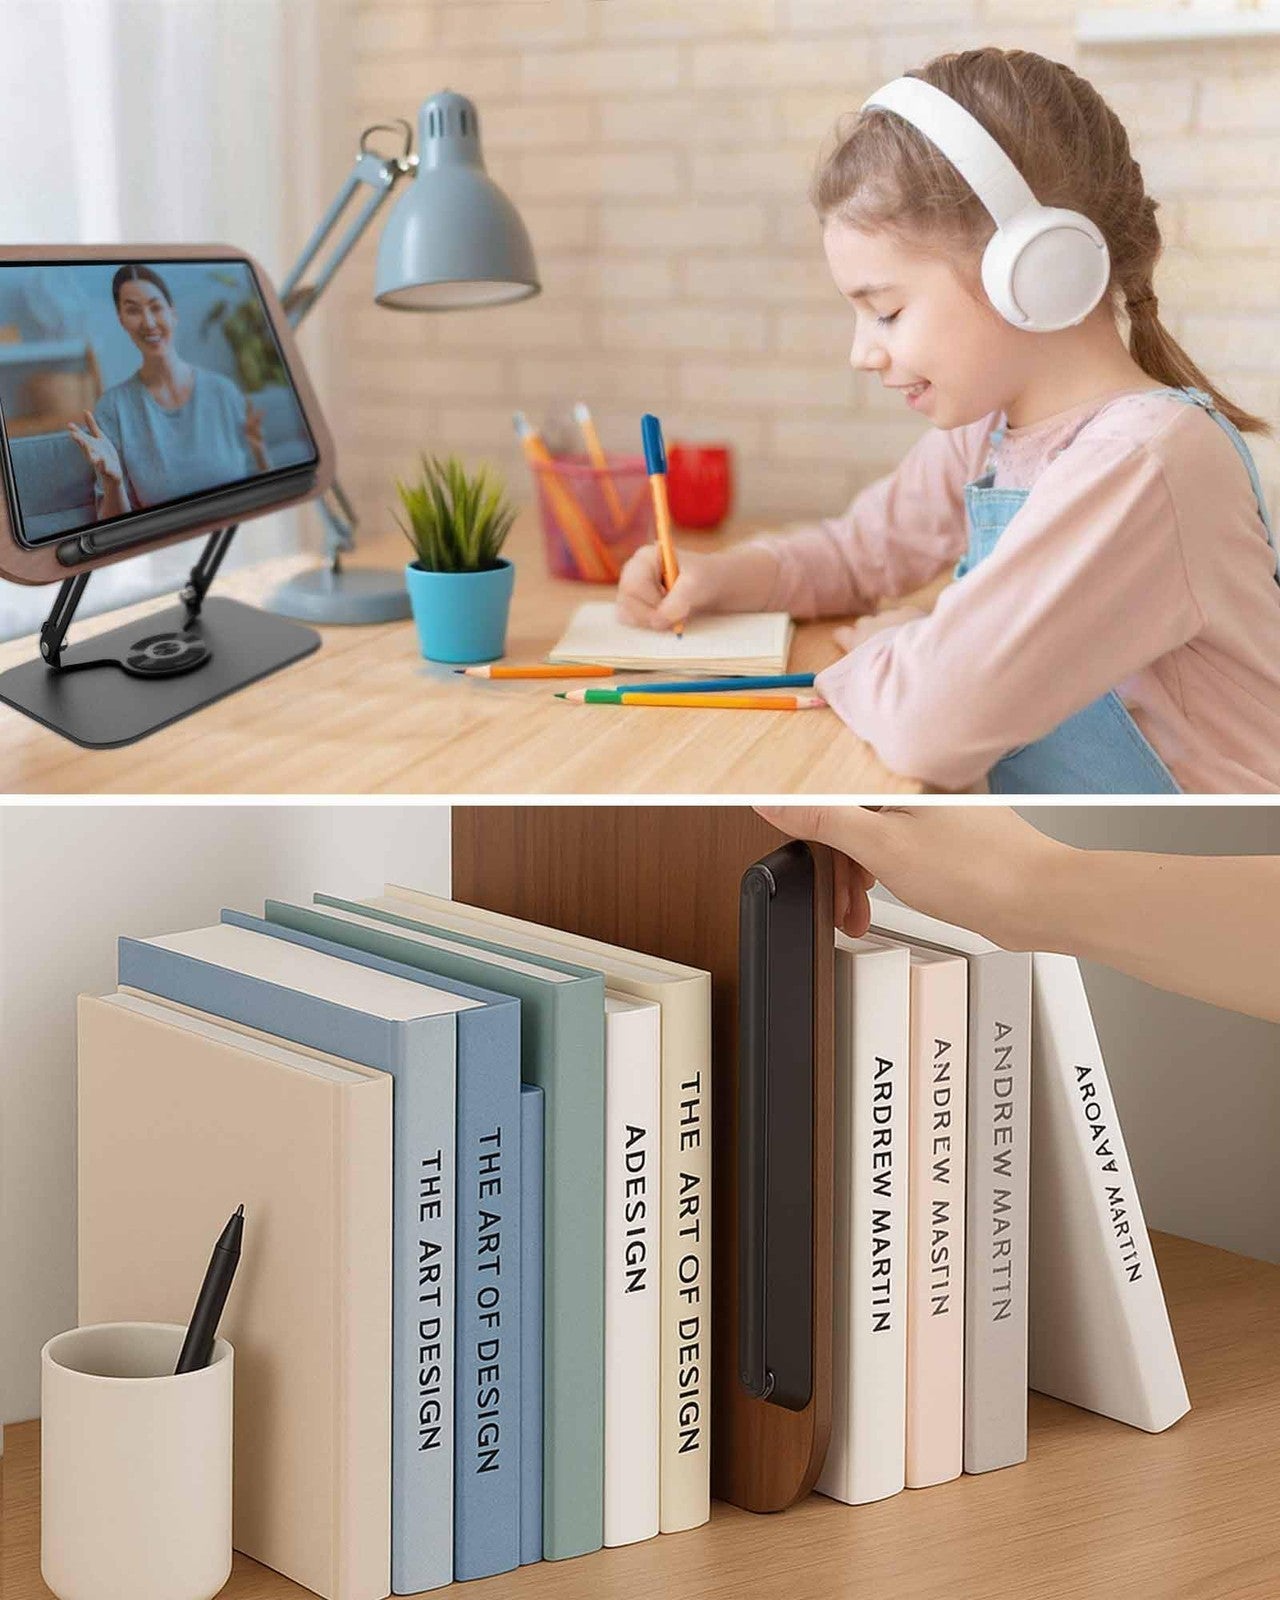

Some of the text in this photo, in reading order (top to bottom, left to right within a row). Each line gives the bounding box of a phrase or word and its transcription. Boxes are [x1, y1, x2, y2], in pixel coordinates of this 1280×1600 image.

[625, 1125, 647, 1293] ADESIGN
[871, 1056, 894, 1333] ARDREW MARTIN
[932, 1038, 952, 1184] ANDREW
[992, 1021, 1013, 1177] ANDREW
[418, 1149, 442, 1452] THE ART DESIGN
[476, 1126, 502, 1474] THE ART OF DESIGN
[678, 1071, 701, 1454] THE ART OF DESIGN
[1104, 1185, 1143, 1283] MARTIN
